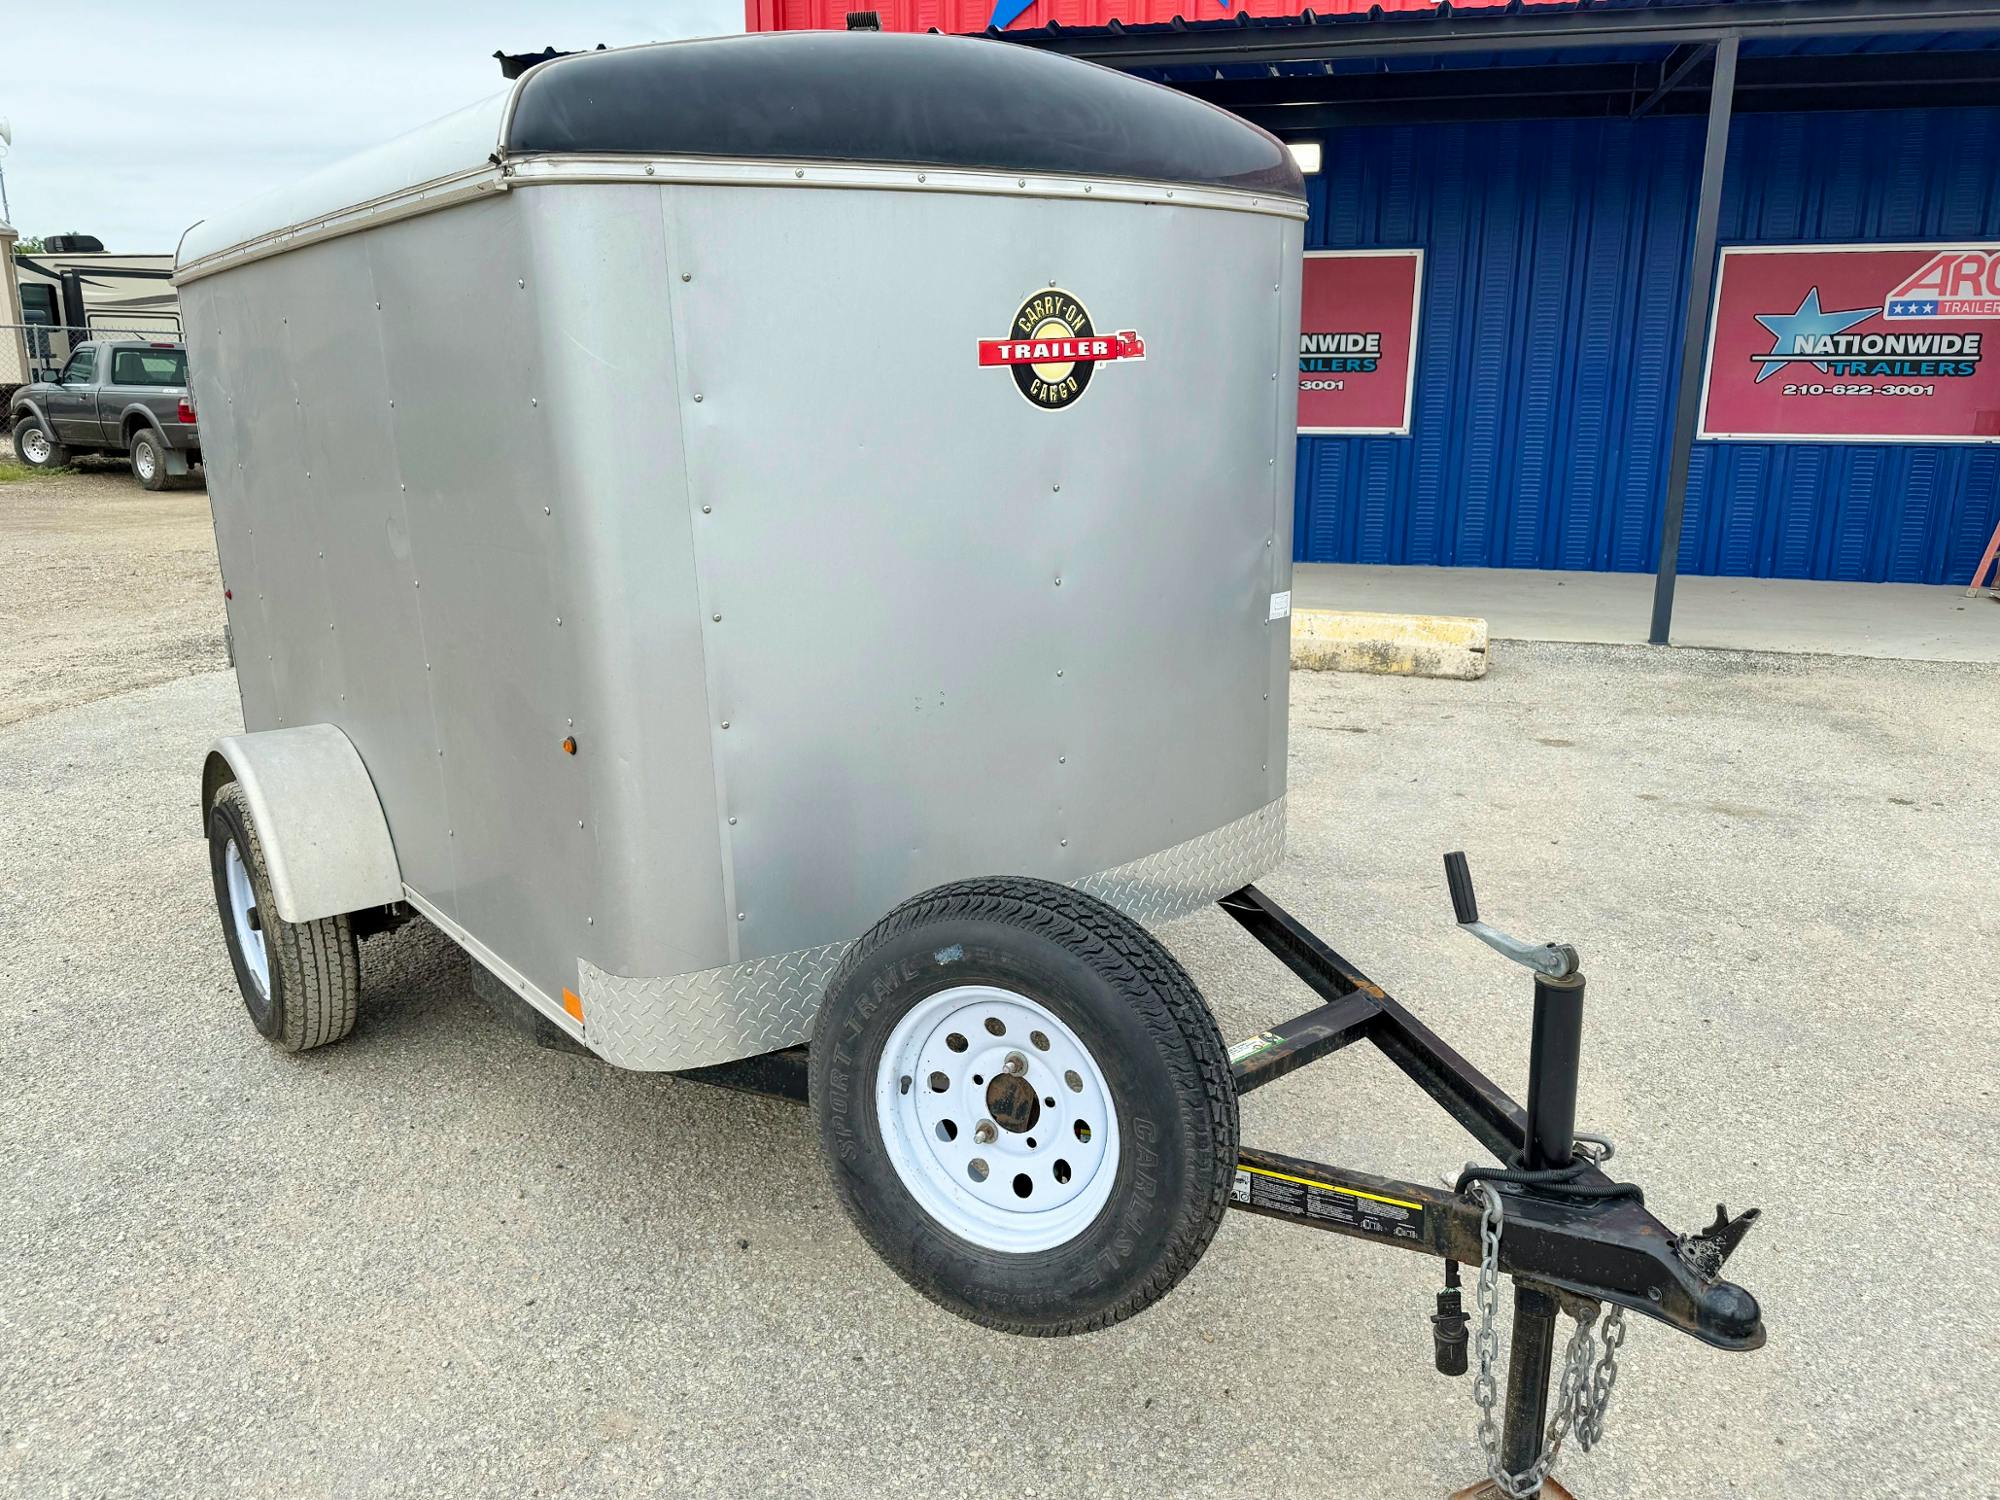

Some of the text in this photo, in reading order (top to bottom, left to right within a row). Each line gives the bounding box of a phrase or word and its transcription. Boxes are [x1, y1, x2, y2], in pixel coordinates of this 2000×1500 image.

[1018, 296, 1086, 333] CARRY-ON
[998, 341, 1108, 361] TRAILER
[1793, 335, 1980, 355] NATIONWIDE
[1833, 361, 1976, 376] TRAILERS
[1030, 376, 1078, 402] CARGO
[1783, 384, 1934, 396] 210-622-3001
[830, 960, 921, 1162] SPORT TRAIL
[1082, 1115, 1159, 1288] CARLISLE
